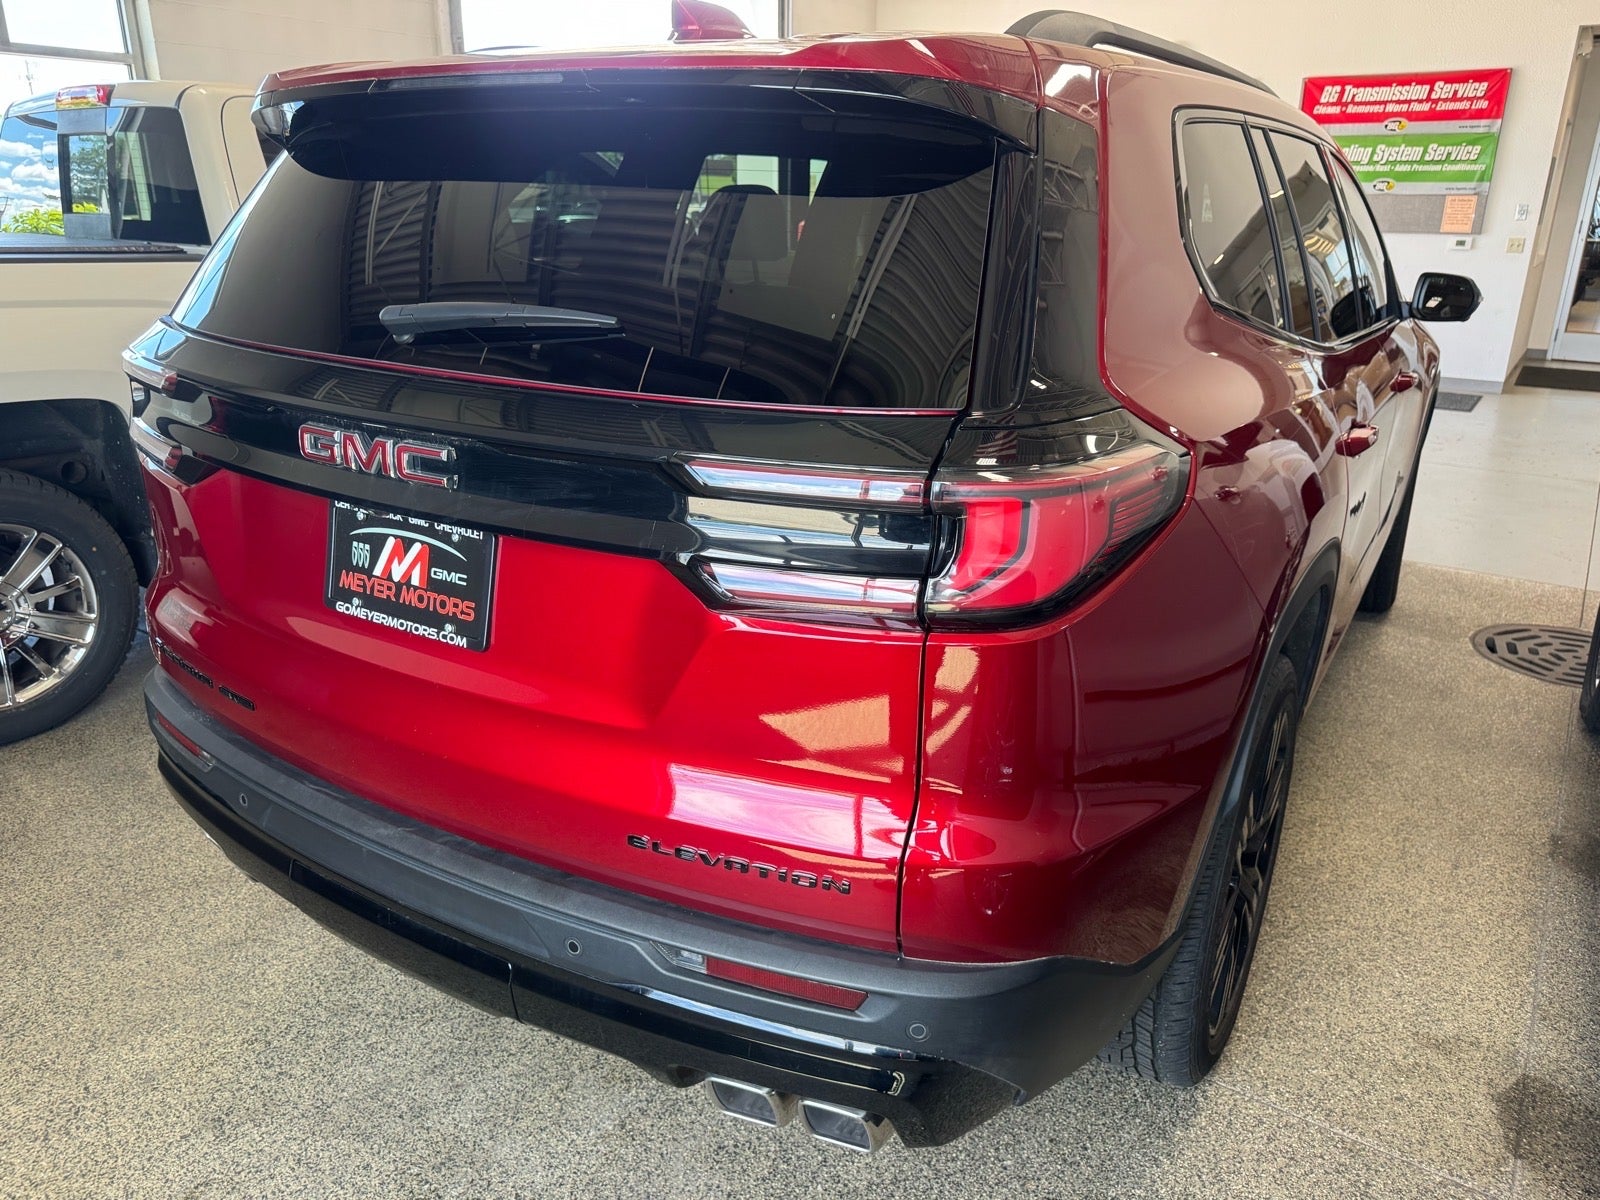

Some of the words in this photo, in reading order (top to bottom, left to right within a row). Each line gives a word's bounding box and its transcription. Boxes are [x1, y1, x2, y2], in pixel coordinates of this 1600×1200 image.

[1320, 85, 1342, 104] BG
[1342, 82, 1430, 103] Transmission
[1431, 79, 1489, 99] Service
[1313, 104, 1341, 115] Cleans
[1346, 102, 1385, 114] Removes
[1385, 102, 1409, 112] Worn
[1409, 101, 1432, 112] Fluid
[1436, 99, 1471, 111] Extends
[1471, 99, 1489, 109] Life
[1373, 144, 1424, 165] System
[1424, 143, 1482, 161] Service
[1412, 163, 1442, 172] Premium
[1442, 163, 1487, 172] Conditioners
[298, 422, 457, 490] GMC
[431, 567, 468, 586] GMC
[339, 569, 396, 602] MEYER
[400, 585, 476, 622] MOTORS
[335, 601, 467, 648] GOMEYERMOTORS.COM
[627, 834, 851, 895] ELEVATION
